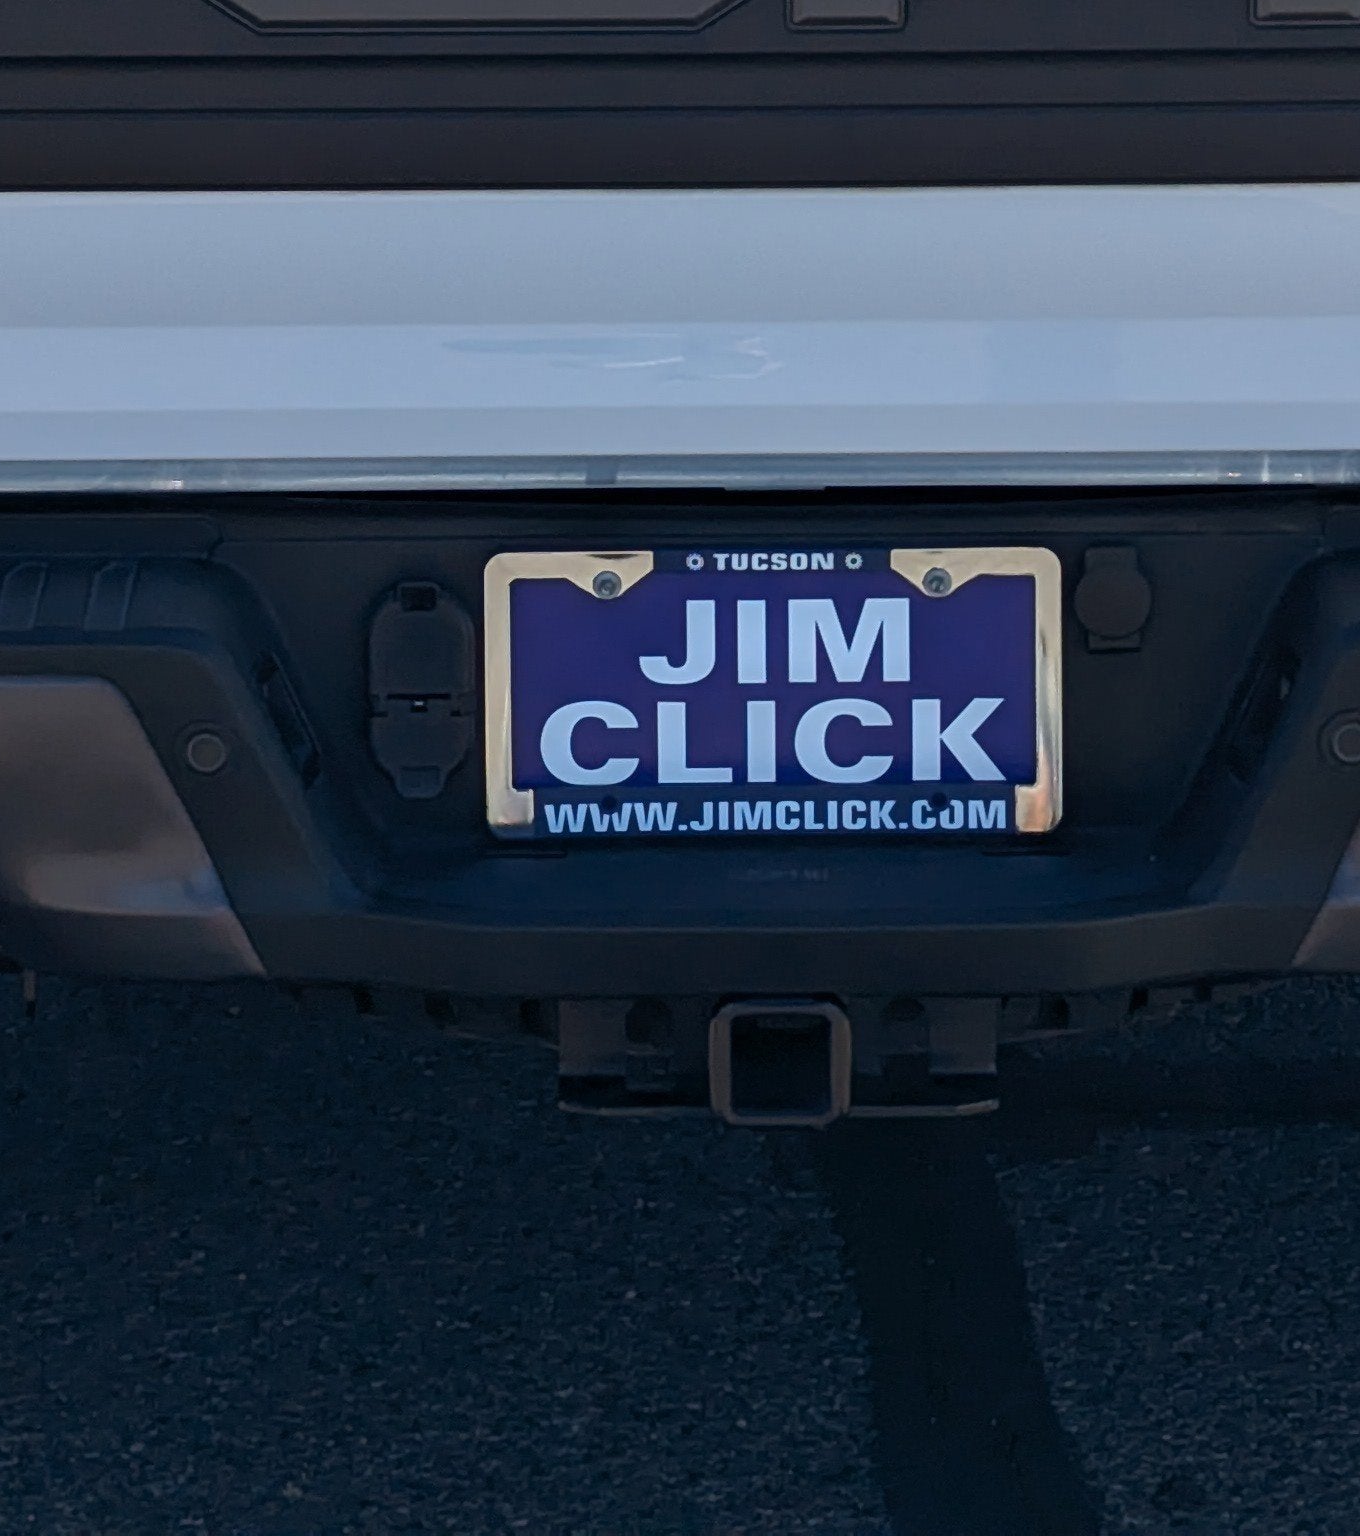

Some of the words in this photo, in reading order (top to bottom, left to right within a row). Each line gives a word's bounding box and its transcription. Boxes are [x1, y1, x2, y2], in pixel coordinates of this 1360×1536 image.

[712, 551, 835, 572] TUCSON
[639, 597, 911, 685] JIM
[539, 697, 1007, 786] CLICK
[543, 798, 1007, 834] WWW.JIMCLICK.COM
